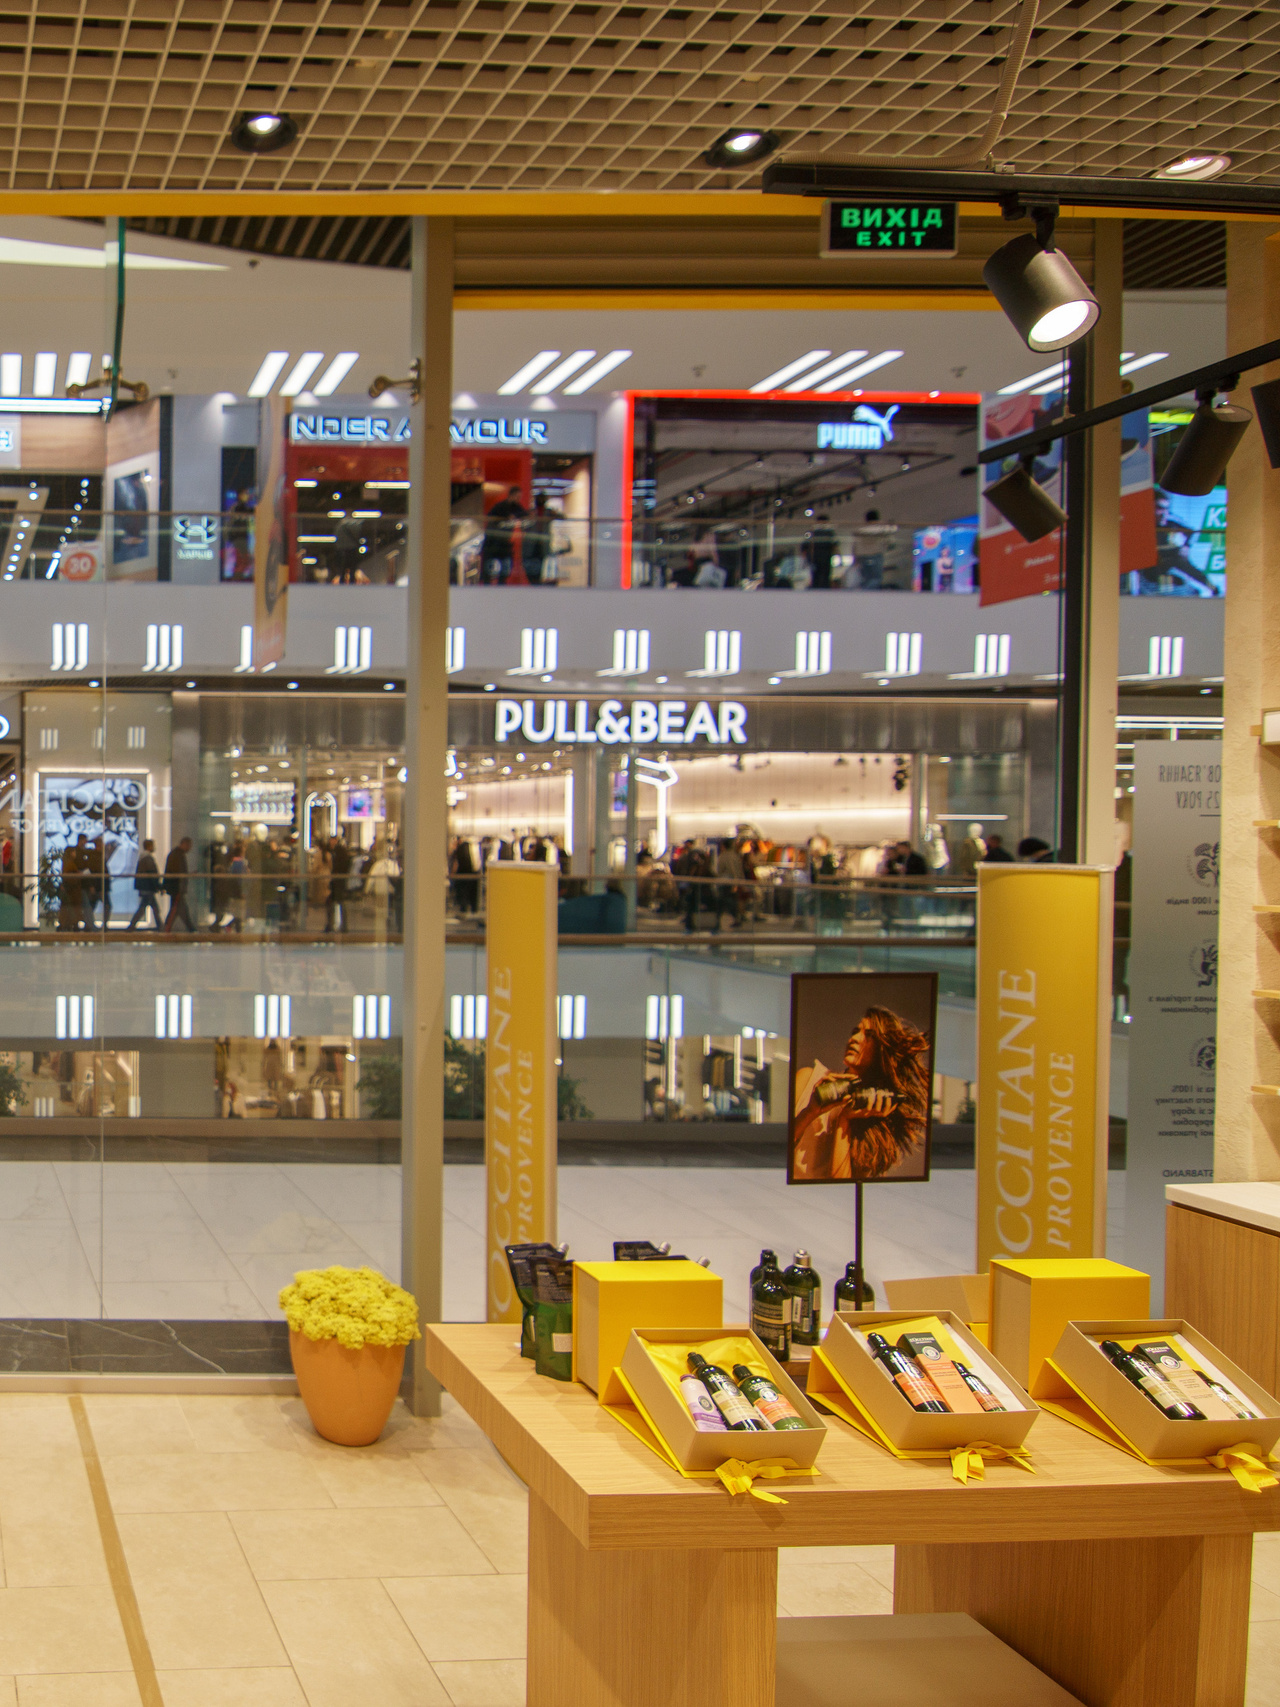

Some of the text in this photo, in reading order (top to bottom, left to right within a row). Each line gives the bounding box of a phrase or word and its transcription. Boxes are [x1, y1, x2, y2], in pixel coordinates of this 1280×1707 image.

[841, 207, 943, 229] ВИХІД
[856, 231, 926, 247] EXIT
[290, 414, 549, 444] NDER AMOUR
[817, 422, 883, 449] PUMA
[495, 700, 748, 744] PULL&BEAR
[995, 968, 1037, 1259] CCITANE
[492, 966, 512, 1321] 'OCCITANE
[517, 1049, 533, 1242] PROVENCE
[1047, 1052, 1075, 1250] PROVENCE
